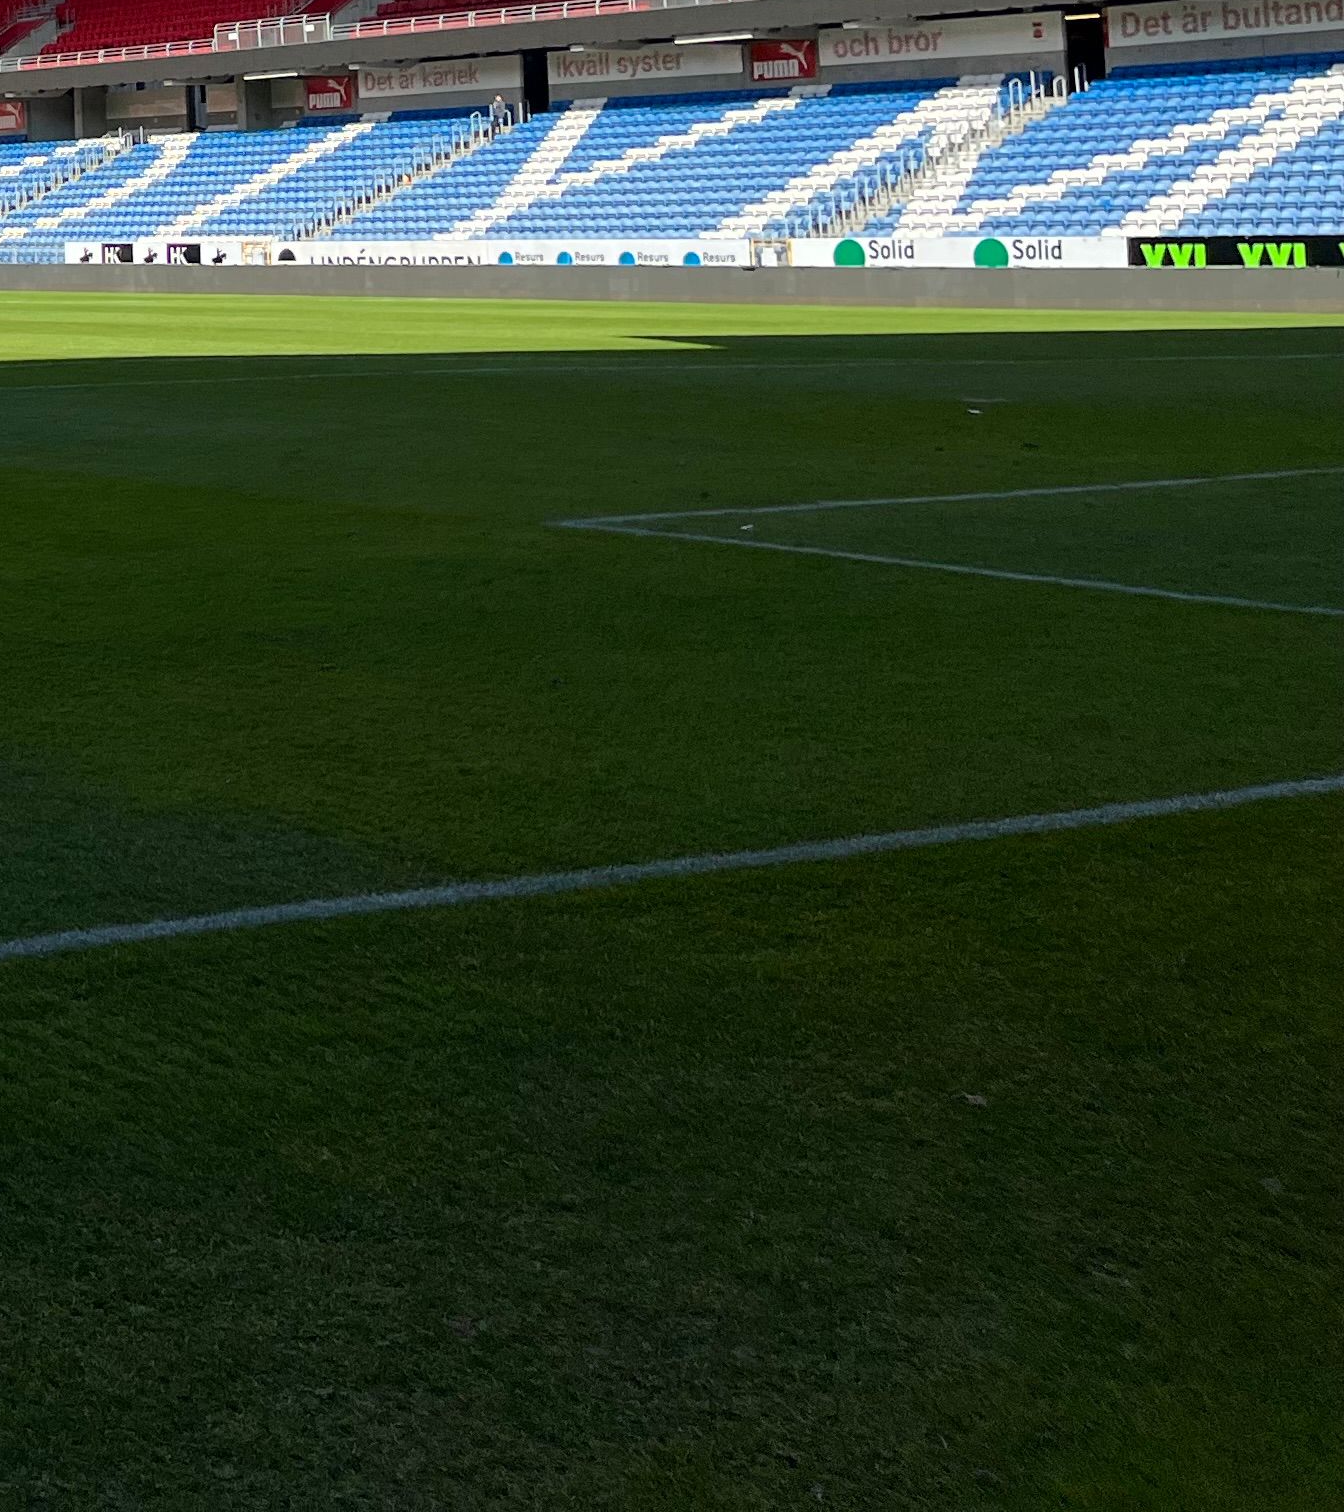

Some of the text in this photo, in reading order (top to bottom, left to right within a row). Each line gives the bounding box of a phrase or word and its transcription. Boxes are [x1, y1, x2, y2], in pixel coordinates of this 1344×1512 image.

[1120, 10, 1173, 38] Det
[1182, 5, 1212, 34] är
[833, 31, 879, 58] och
[556, 50, 684, 78] ikväll syster
[753, 59, 799, 79] PUMA
[364, 72, 394, 91] Det
[399, 68, 416, 90] är
[309, 92, 341, 109] PUMA
[515, 251, 544, 262] Resurs
[575, 251, 605, 262] Resurs
[637, 251, 669, 263] Resurs
[703, 252, 736, 263] Resurs
[868, 239, 915, 260] Solid
[1013, 239, 1062, 260] Solid
